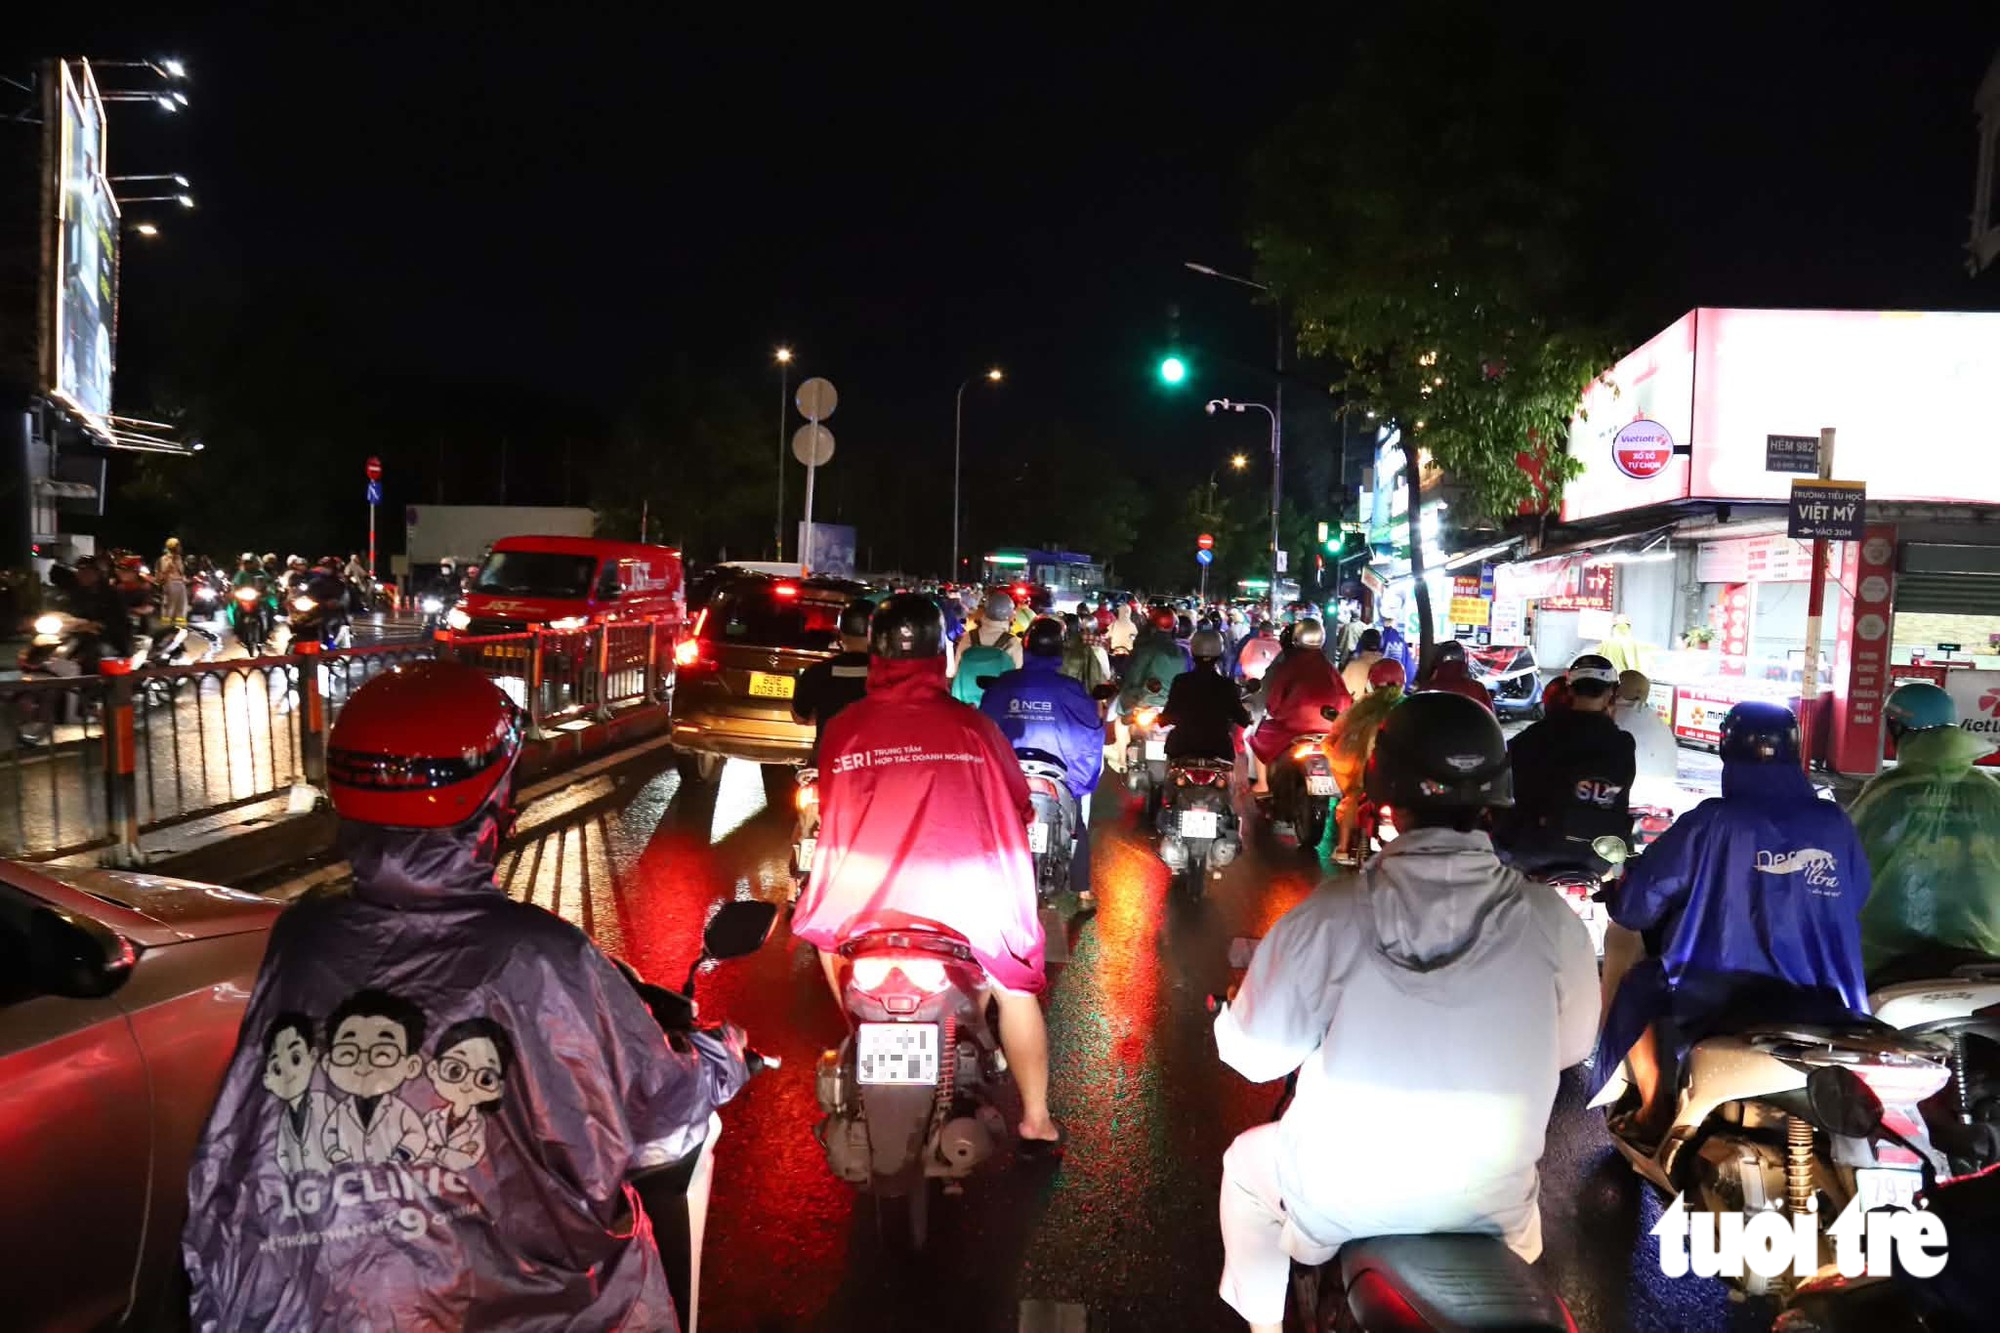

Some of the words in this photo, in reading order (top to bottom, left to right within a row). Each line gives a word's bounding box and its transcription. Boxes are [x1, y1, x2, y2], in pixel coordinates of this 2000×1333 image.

[1621, 435, 1655, 443] Vietlott
[1796, 441, 1815, 453] 982
[1793, 490, 1826, 500] TRƯỜNG
[1828, 490, 1844, 500] TIỂU
[1845, 492, 1862, 501] HỌC
[1798, 501, 1830, 524] VIỆT
[1832, 502, 1857, 522] MỸ
[1586, 575, 1607, 590] TỶ
[1022, 700, 1052, 711] NCB
[873, 748, 902, 757] TRUNG
[903, 744, 922, 754] TÂM
[894, 754, 911, 763] TÁC
[912, 753, 943, 762] DOANH
[333, 1165, 469, 1207] CLINIC
